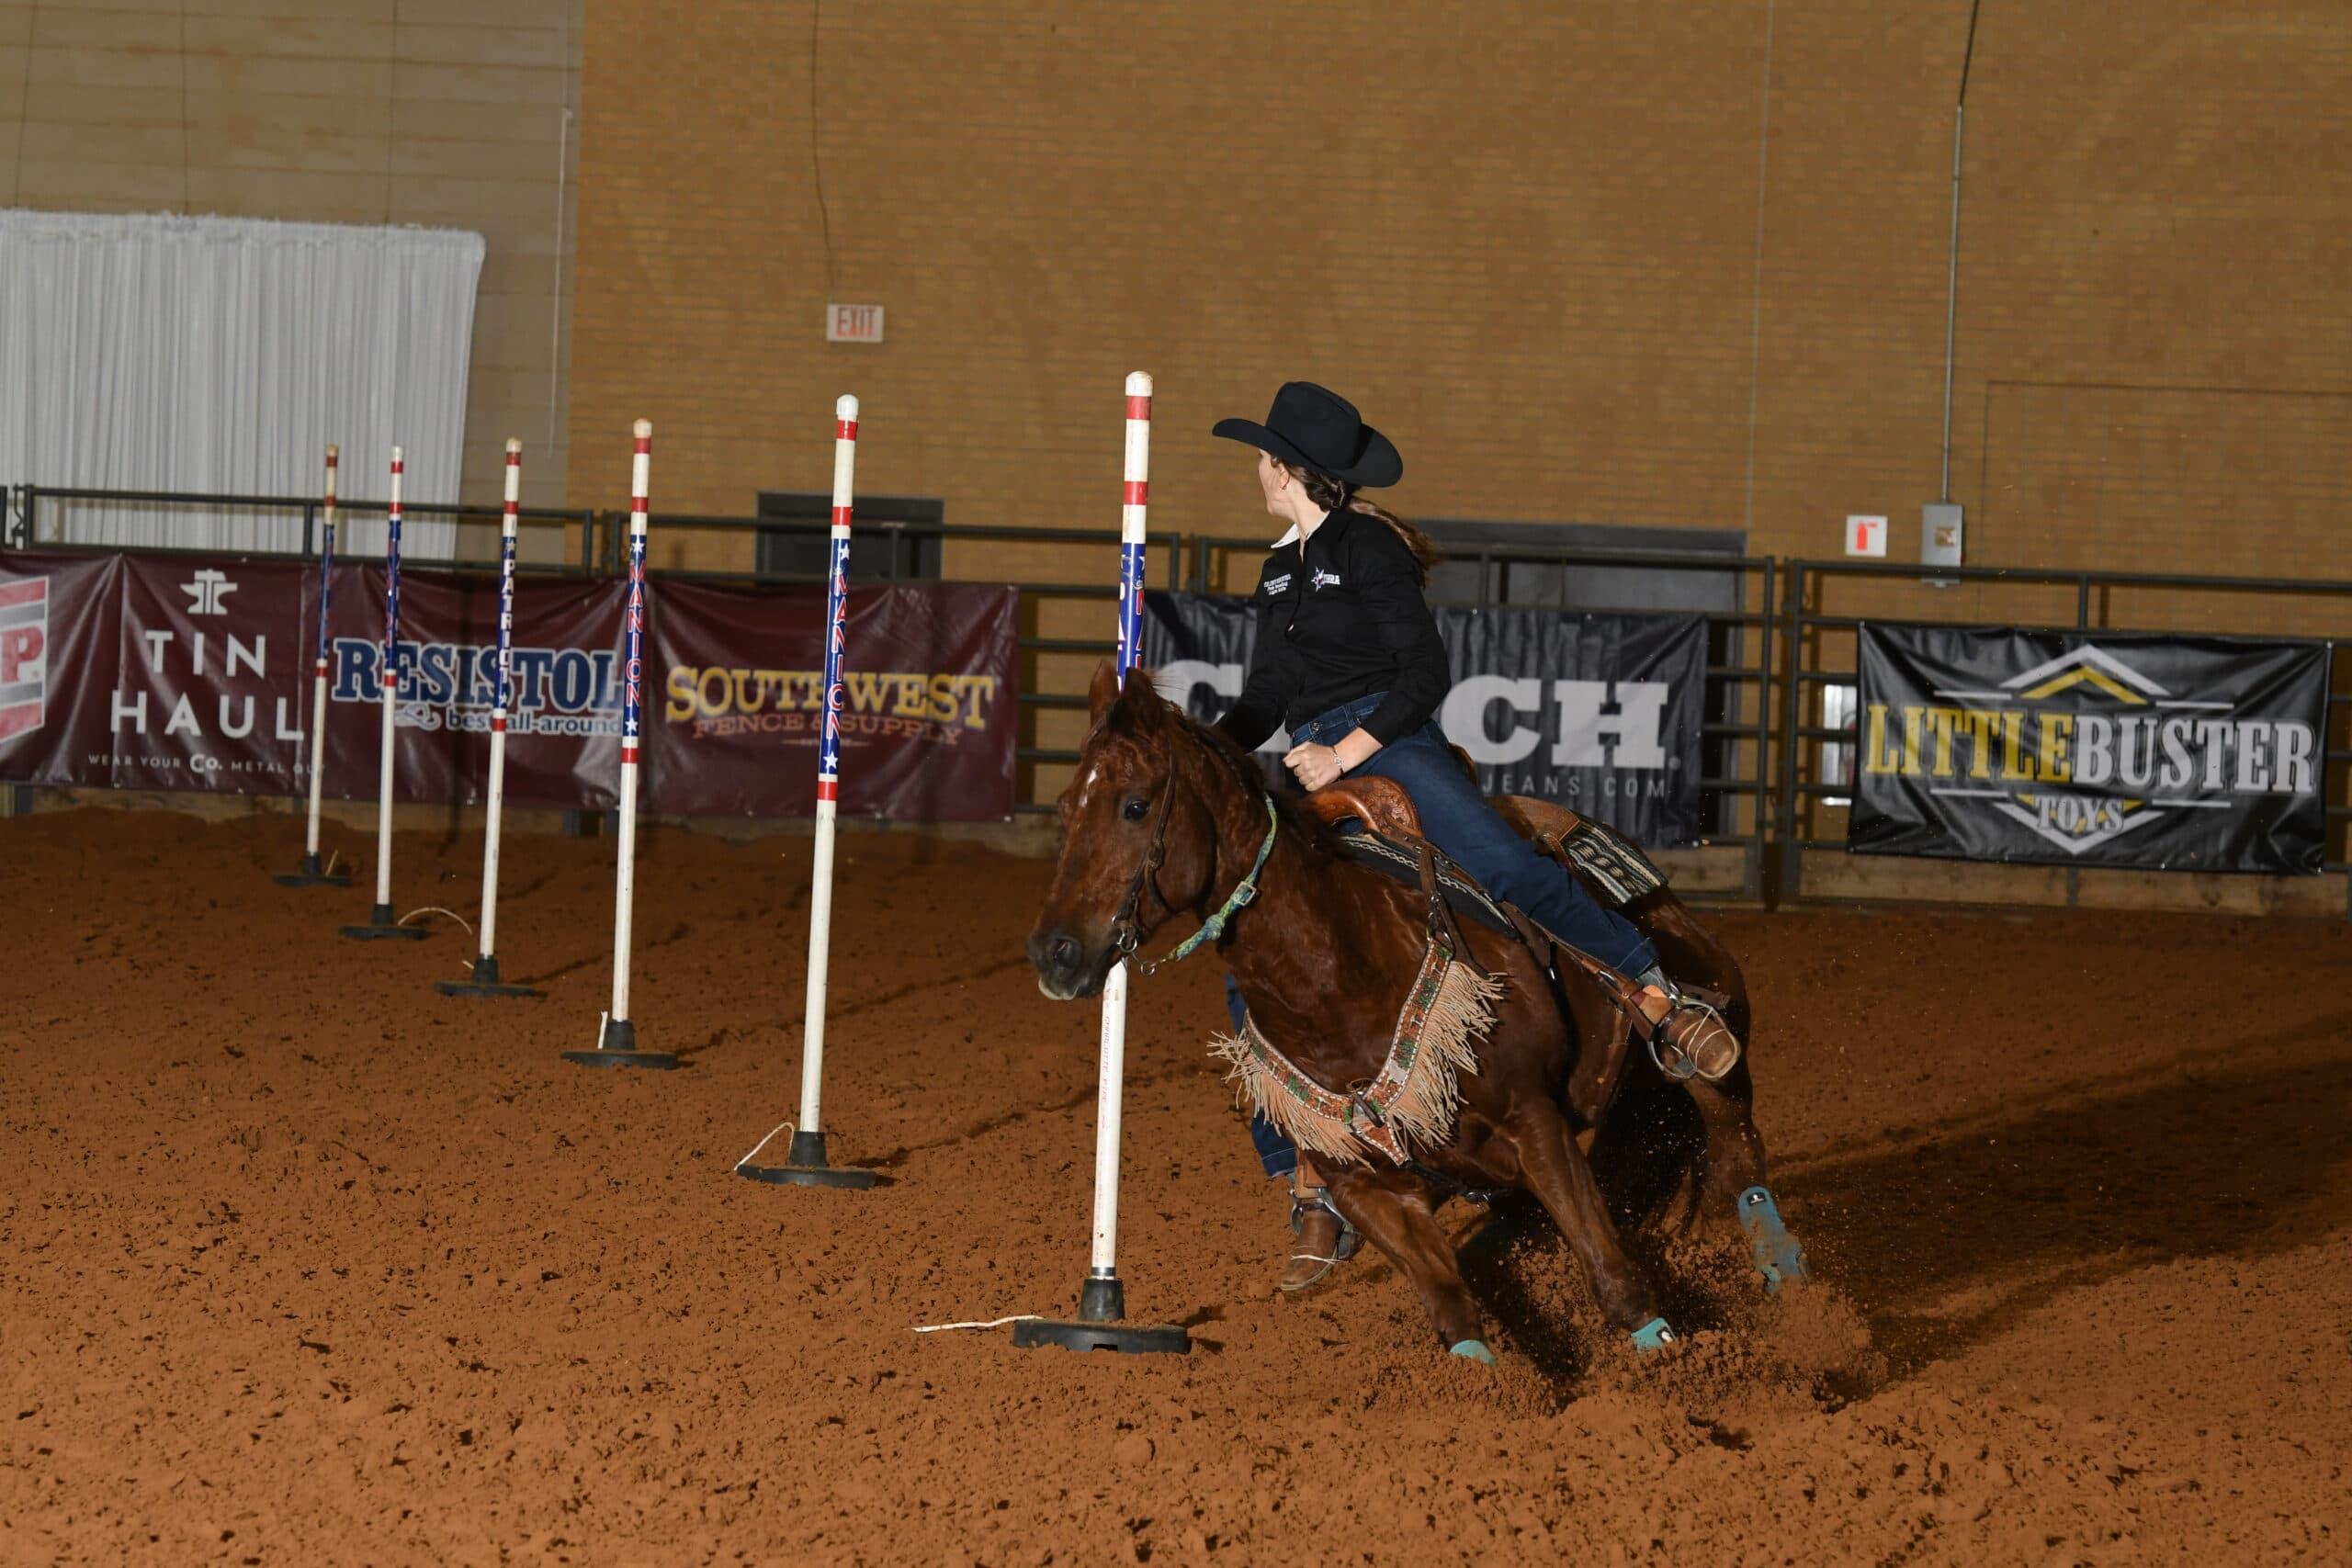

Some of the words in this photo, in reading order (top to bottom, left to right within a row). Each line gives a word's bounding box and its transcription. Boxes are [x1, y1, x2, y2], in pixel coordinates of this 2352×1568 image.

[837, 307, 876, 338] EXIT
[627, 560, 646, 707] MANION
[145, 630, 266, 679] TIN
[110, 690, 304, 741] HAUL
[446, 705, 493, 732] bes
[506, 711, 624, 735] all-around
[693, 713, 805, 739] FENCE
[841, 713, 963, 746] SUPPLY
[1152, 659, 1668, 770] CCH
[88, 753, 132, 766] WEAR
[141, 756, 181, 768] YOUR
[231, 760, 286, 773] METAL
[293, 762, 326, 775] OU
[2033, 794, 2125, 833] TOYS
